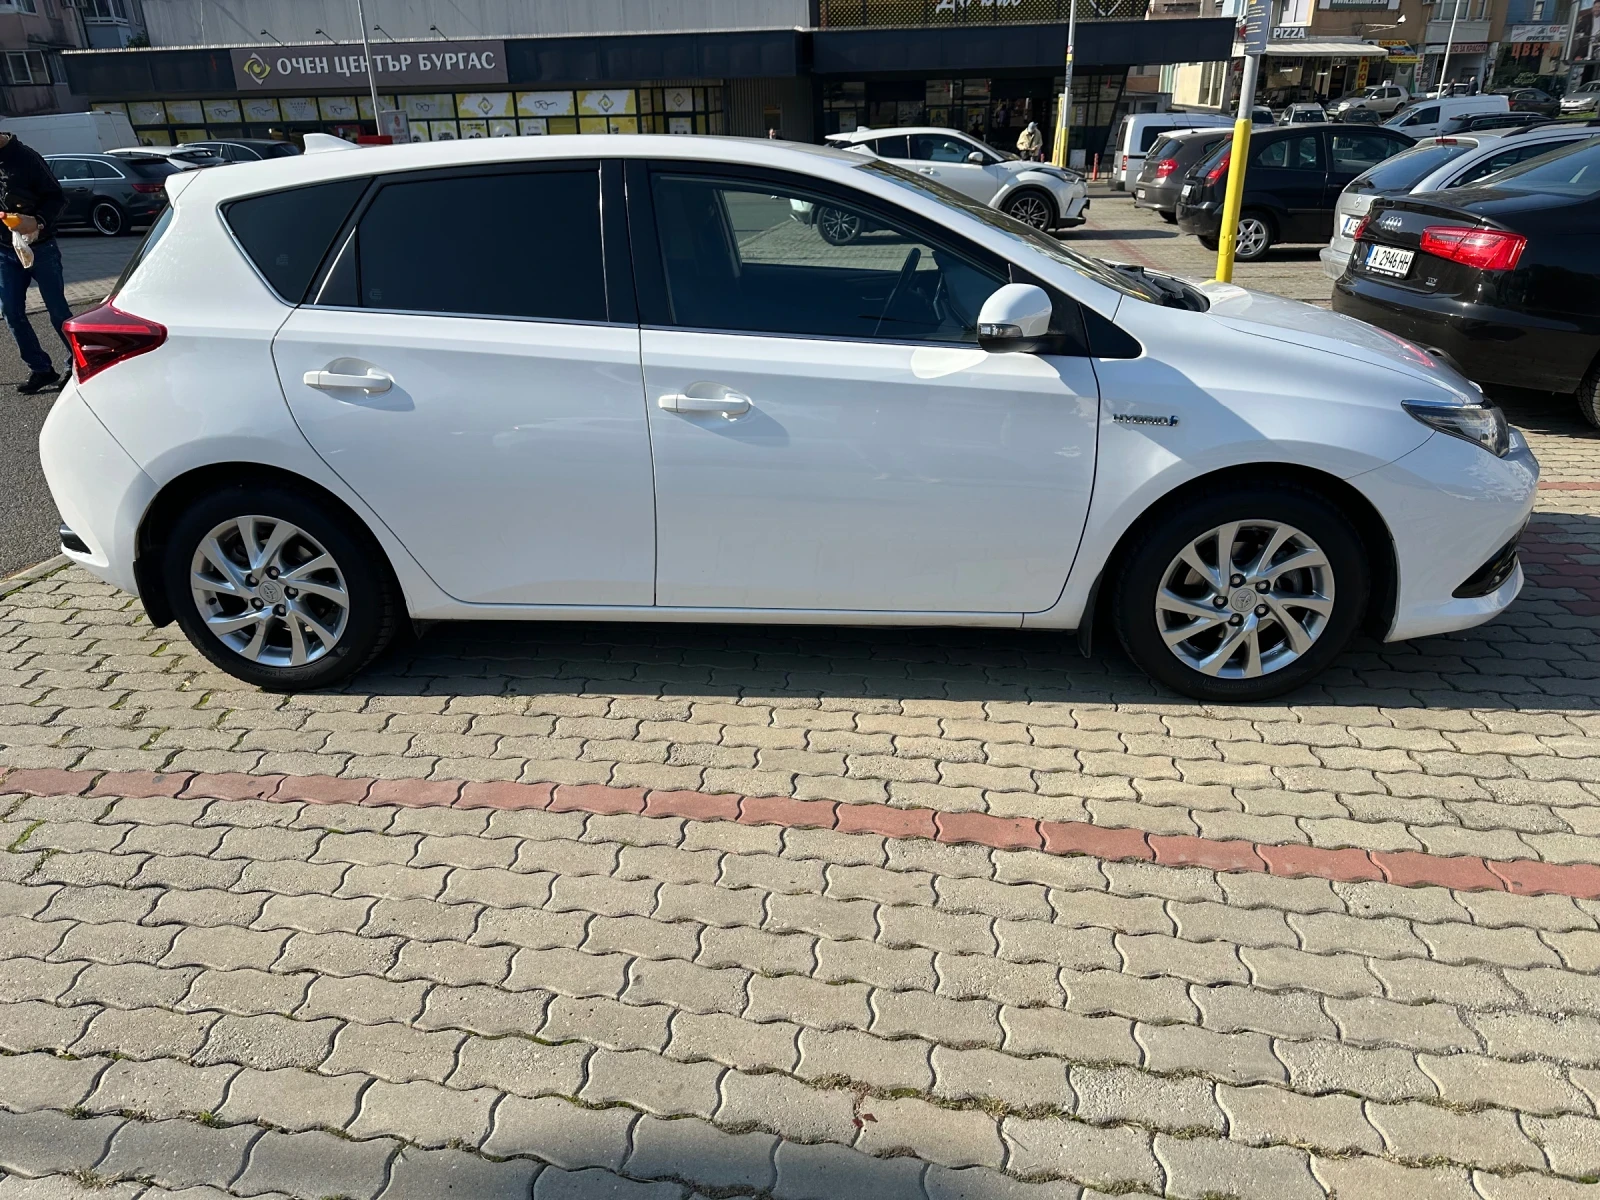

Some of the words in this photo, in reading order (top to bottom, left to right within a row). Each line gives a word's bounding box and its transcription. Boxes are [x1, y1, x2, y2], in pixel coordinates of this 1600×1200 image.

[1272, 27, 1306, 39] PIZZA
[276, 56, 330, 75] ОЧЕН
[333, 54, 412, 77] ЦЕНТЪР
[417, 51, 496, 71] БУРГАС
[1112, 413, 1169, 426] HYBRID
